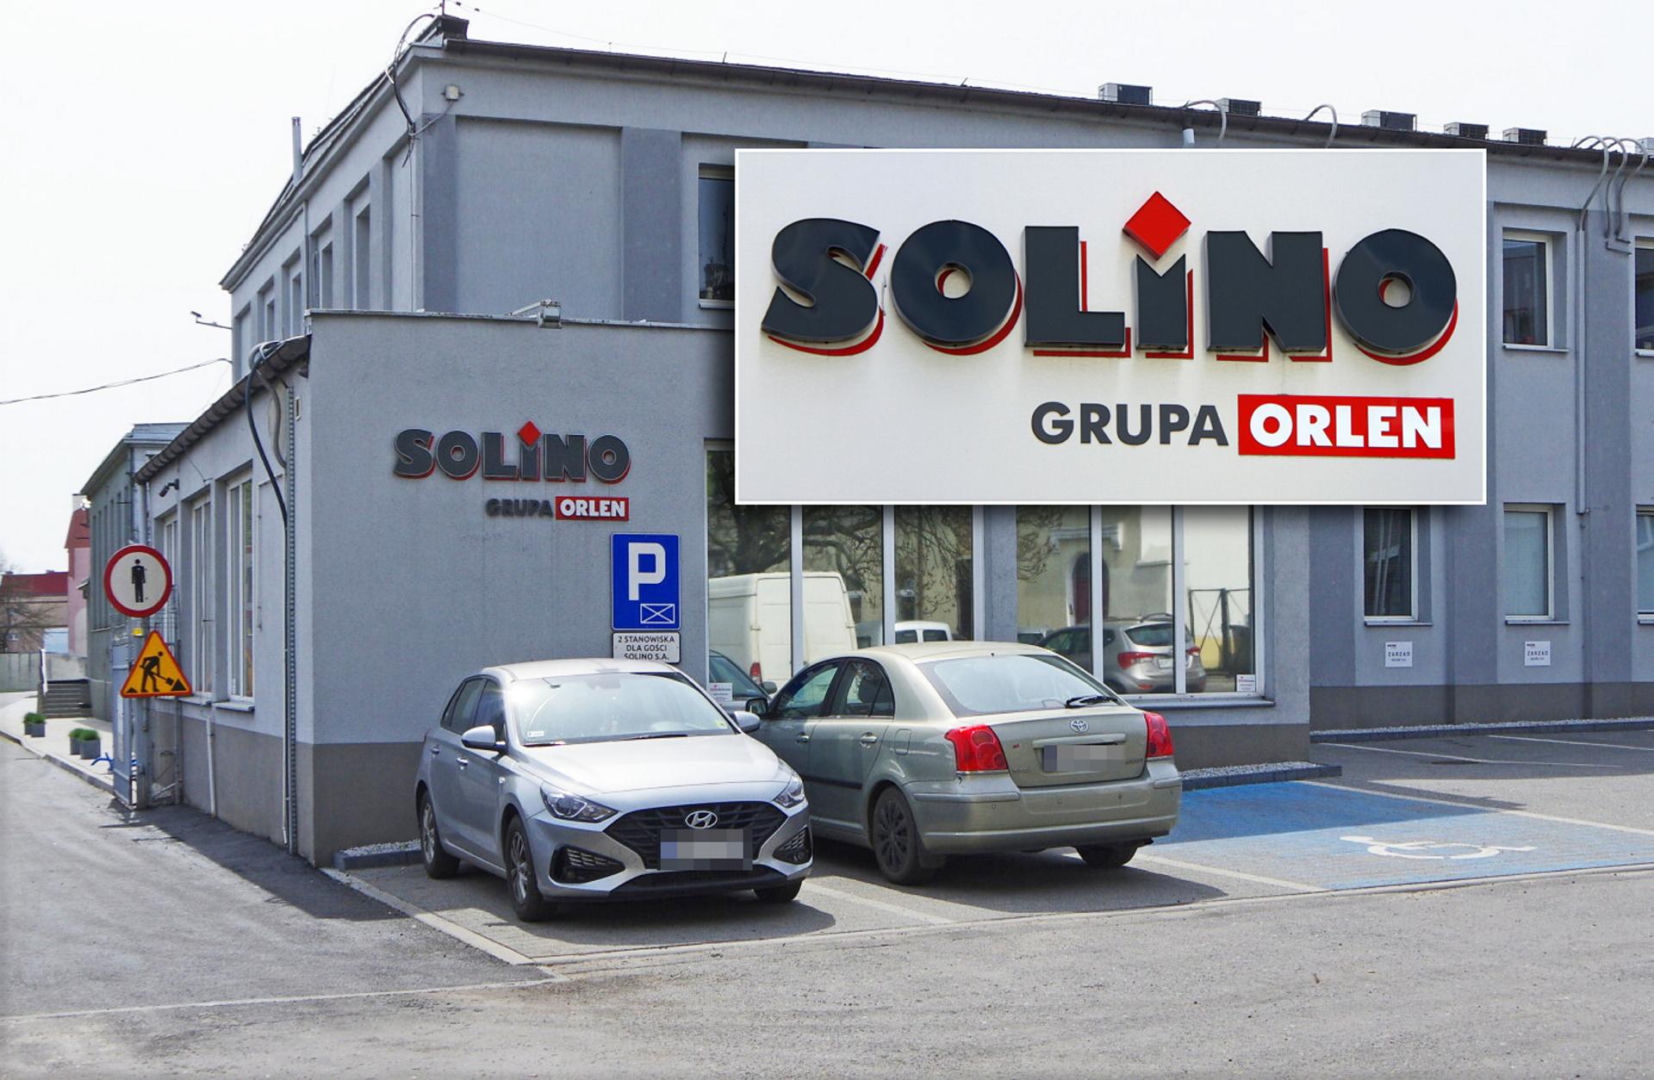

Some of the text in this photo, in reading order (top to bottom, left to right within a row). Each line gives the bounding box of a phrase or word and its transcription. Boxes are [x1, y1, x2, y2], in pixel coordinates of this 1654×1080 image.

[1031, 401, 1442, 448] GRUPA ORLEN
[485, 498, 625, 518] GRUPA ORLEN
[628, 542, 666, 601] P
[618, 635, 675, 643] 2 STANOWISKA
[626, 644, 642, 652] DLA
